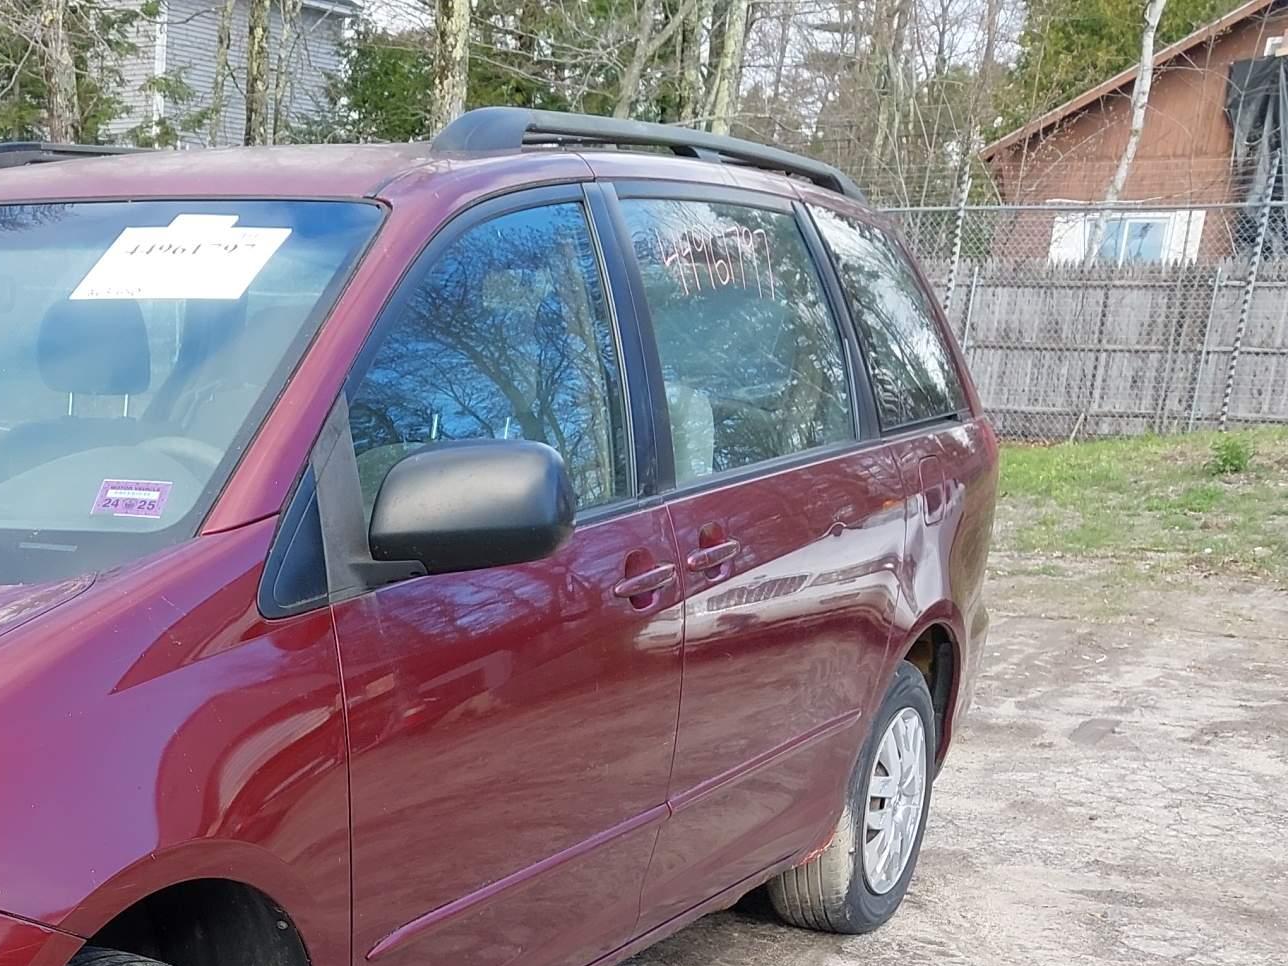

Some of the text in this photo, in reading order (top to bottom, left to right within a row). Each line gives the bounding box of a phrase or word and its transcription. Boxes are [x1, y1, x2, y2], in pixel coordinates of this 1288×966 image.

[654, 222, 775, 301] 44961797
[102, 498, 157, 511] 24 25
